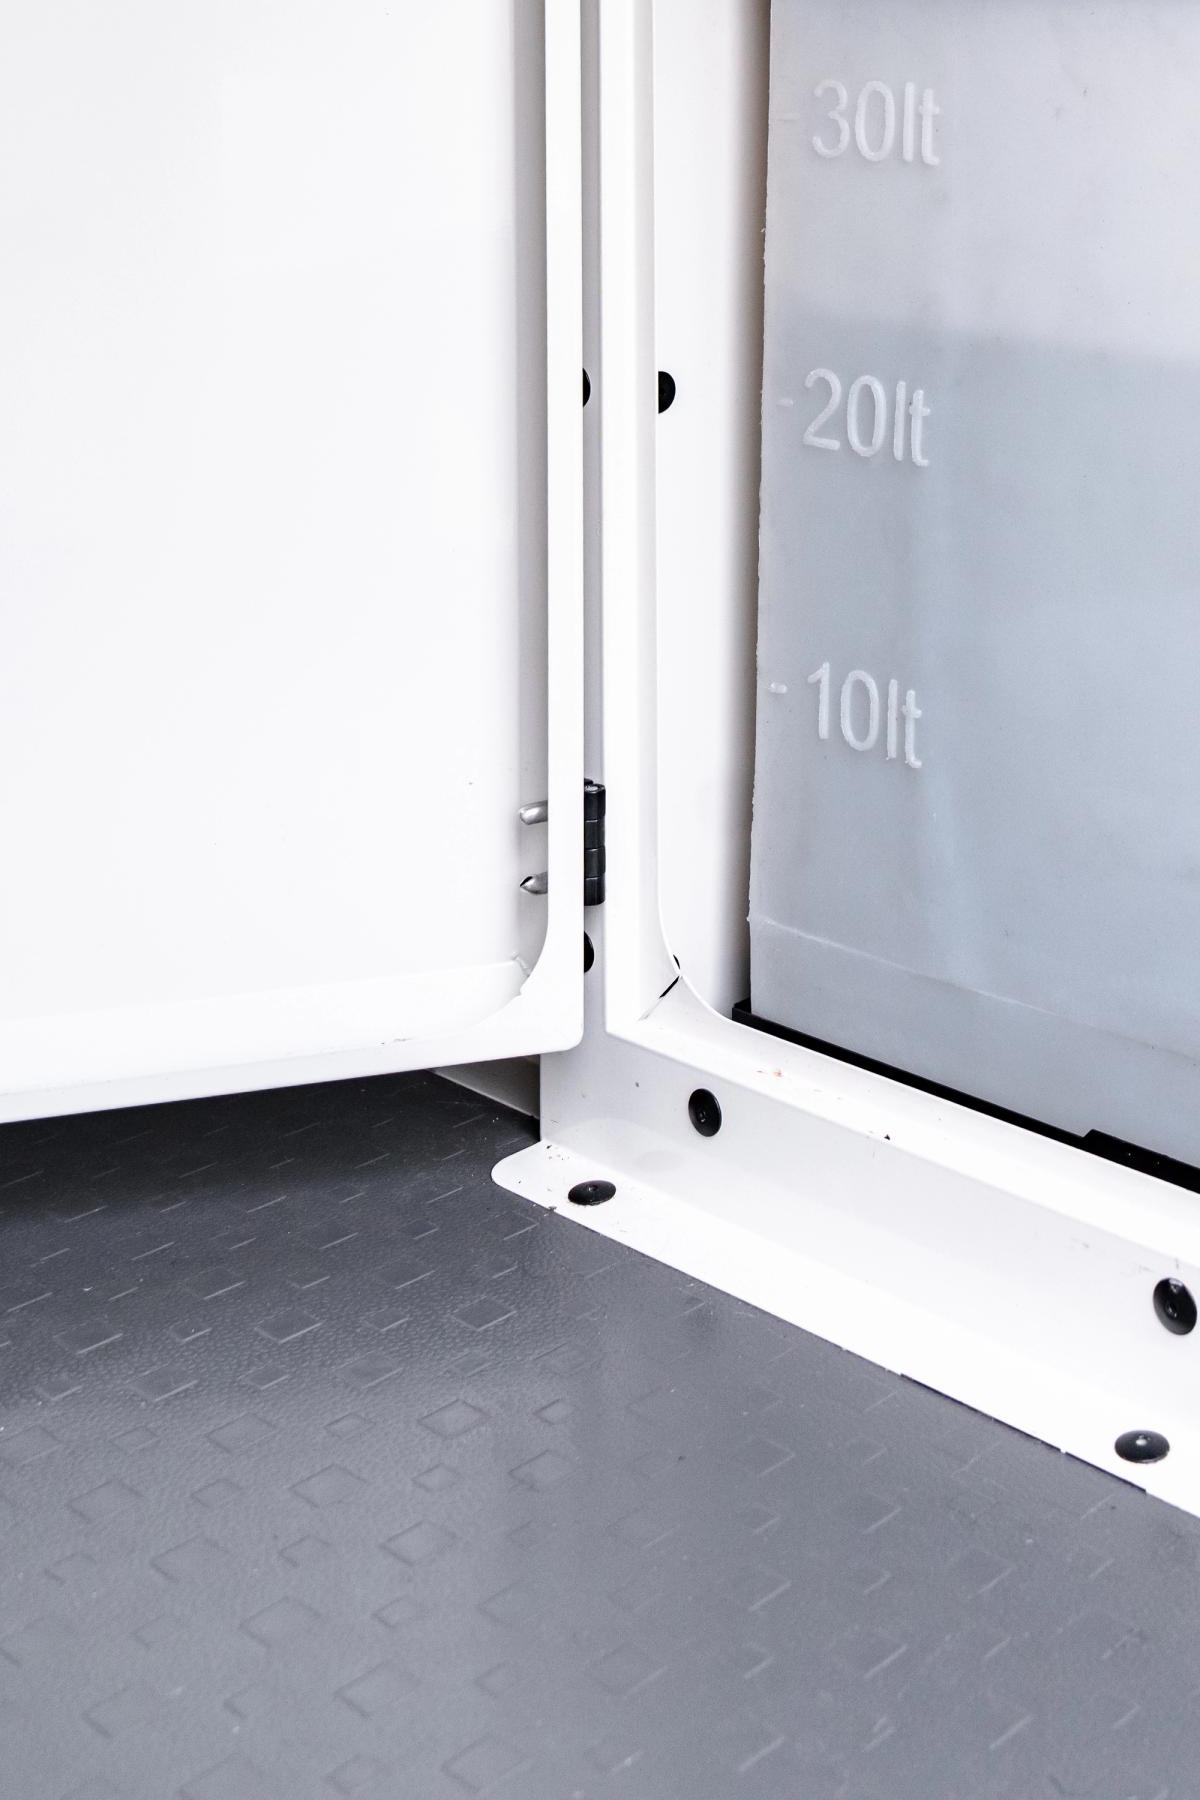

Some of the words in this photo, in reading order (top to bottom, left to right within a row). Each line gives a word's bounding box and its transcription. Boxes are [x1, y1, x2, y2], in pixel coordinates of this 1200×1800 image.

[812, 79, 940, 167] 30lt
[803, 368, 931, 467] 20lt
[807, 661, 922, 769] 10lt
